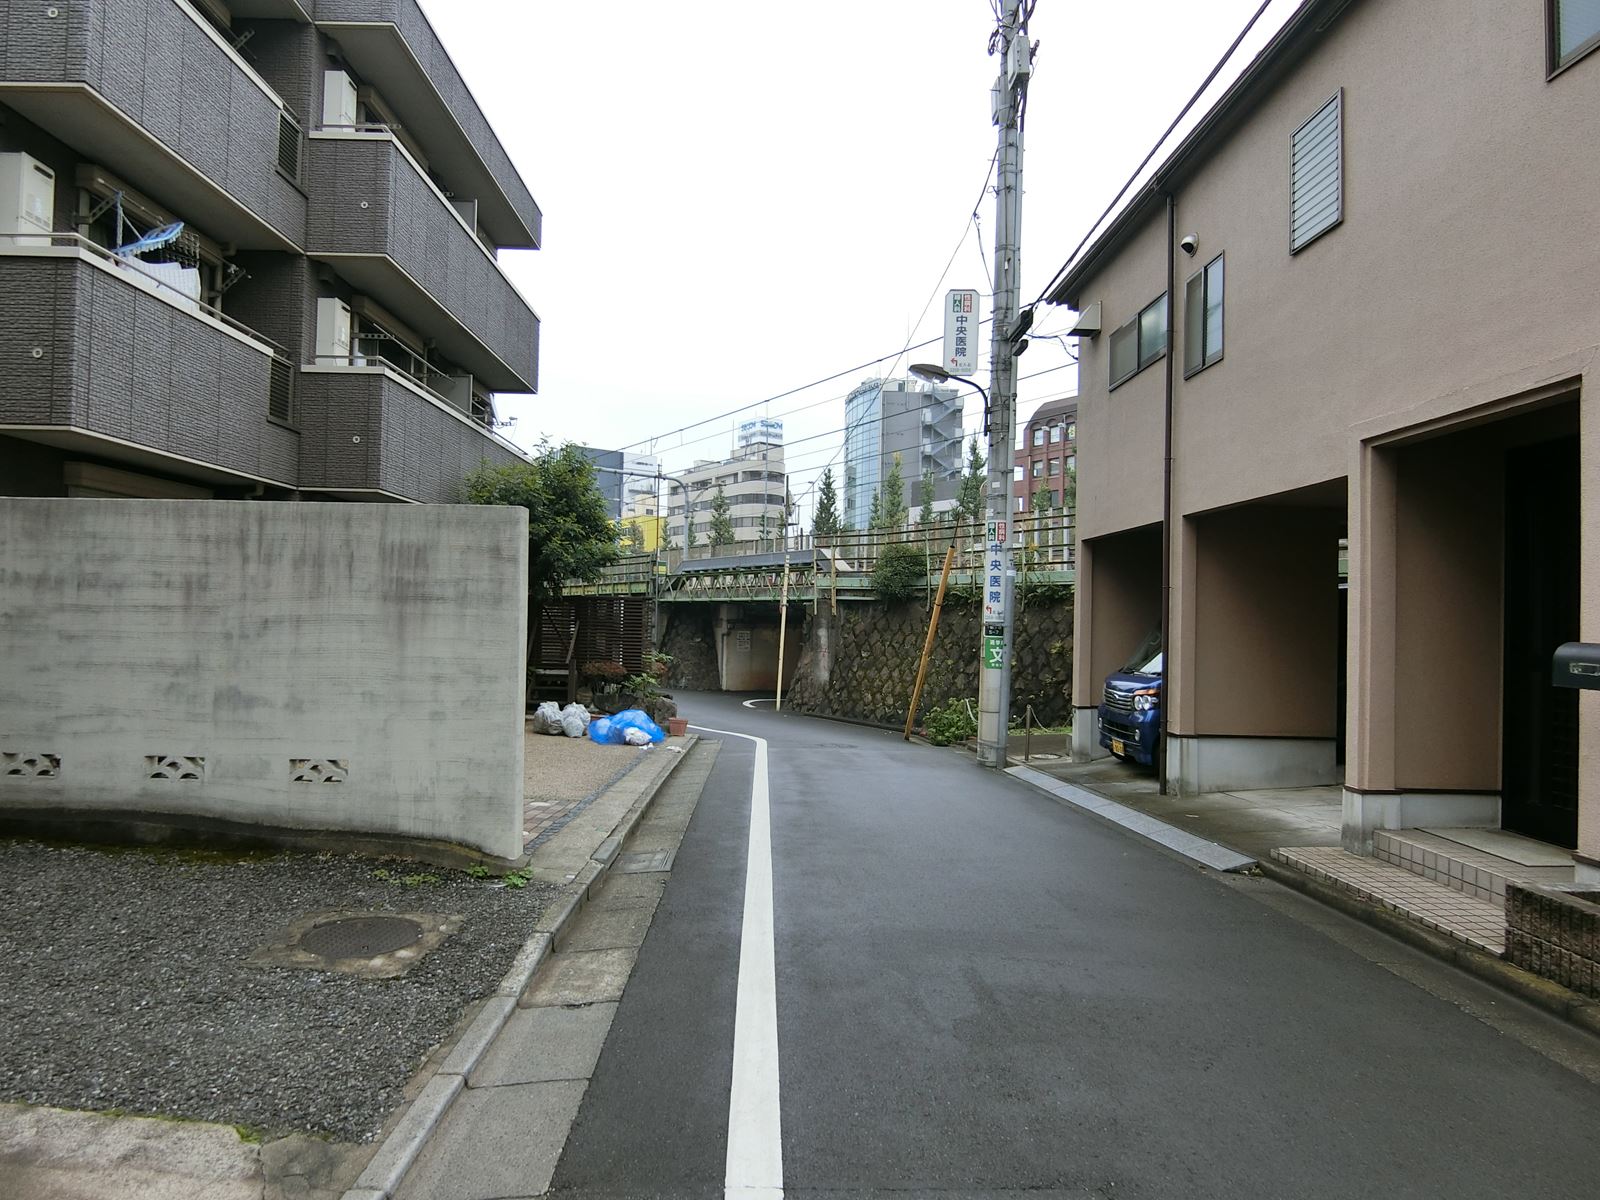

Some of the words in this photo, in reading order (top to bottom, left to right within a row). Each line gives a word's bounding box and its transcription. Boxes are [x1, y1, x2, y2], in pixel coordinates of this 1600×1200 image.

[955, 315, 967, 357] 中央医院
[990, 544, 1002, 603] 中央医院
[989, 647, 1003, 662] 文
